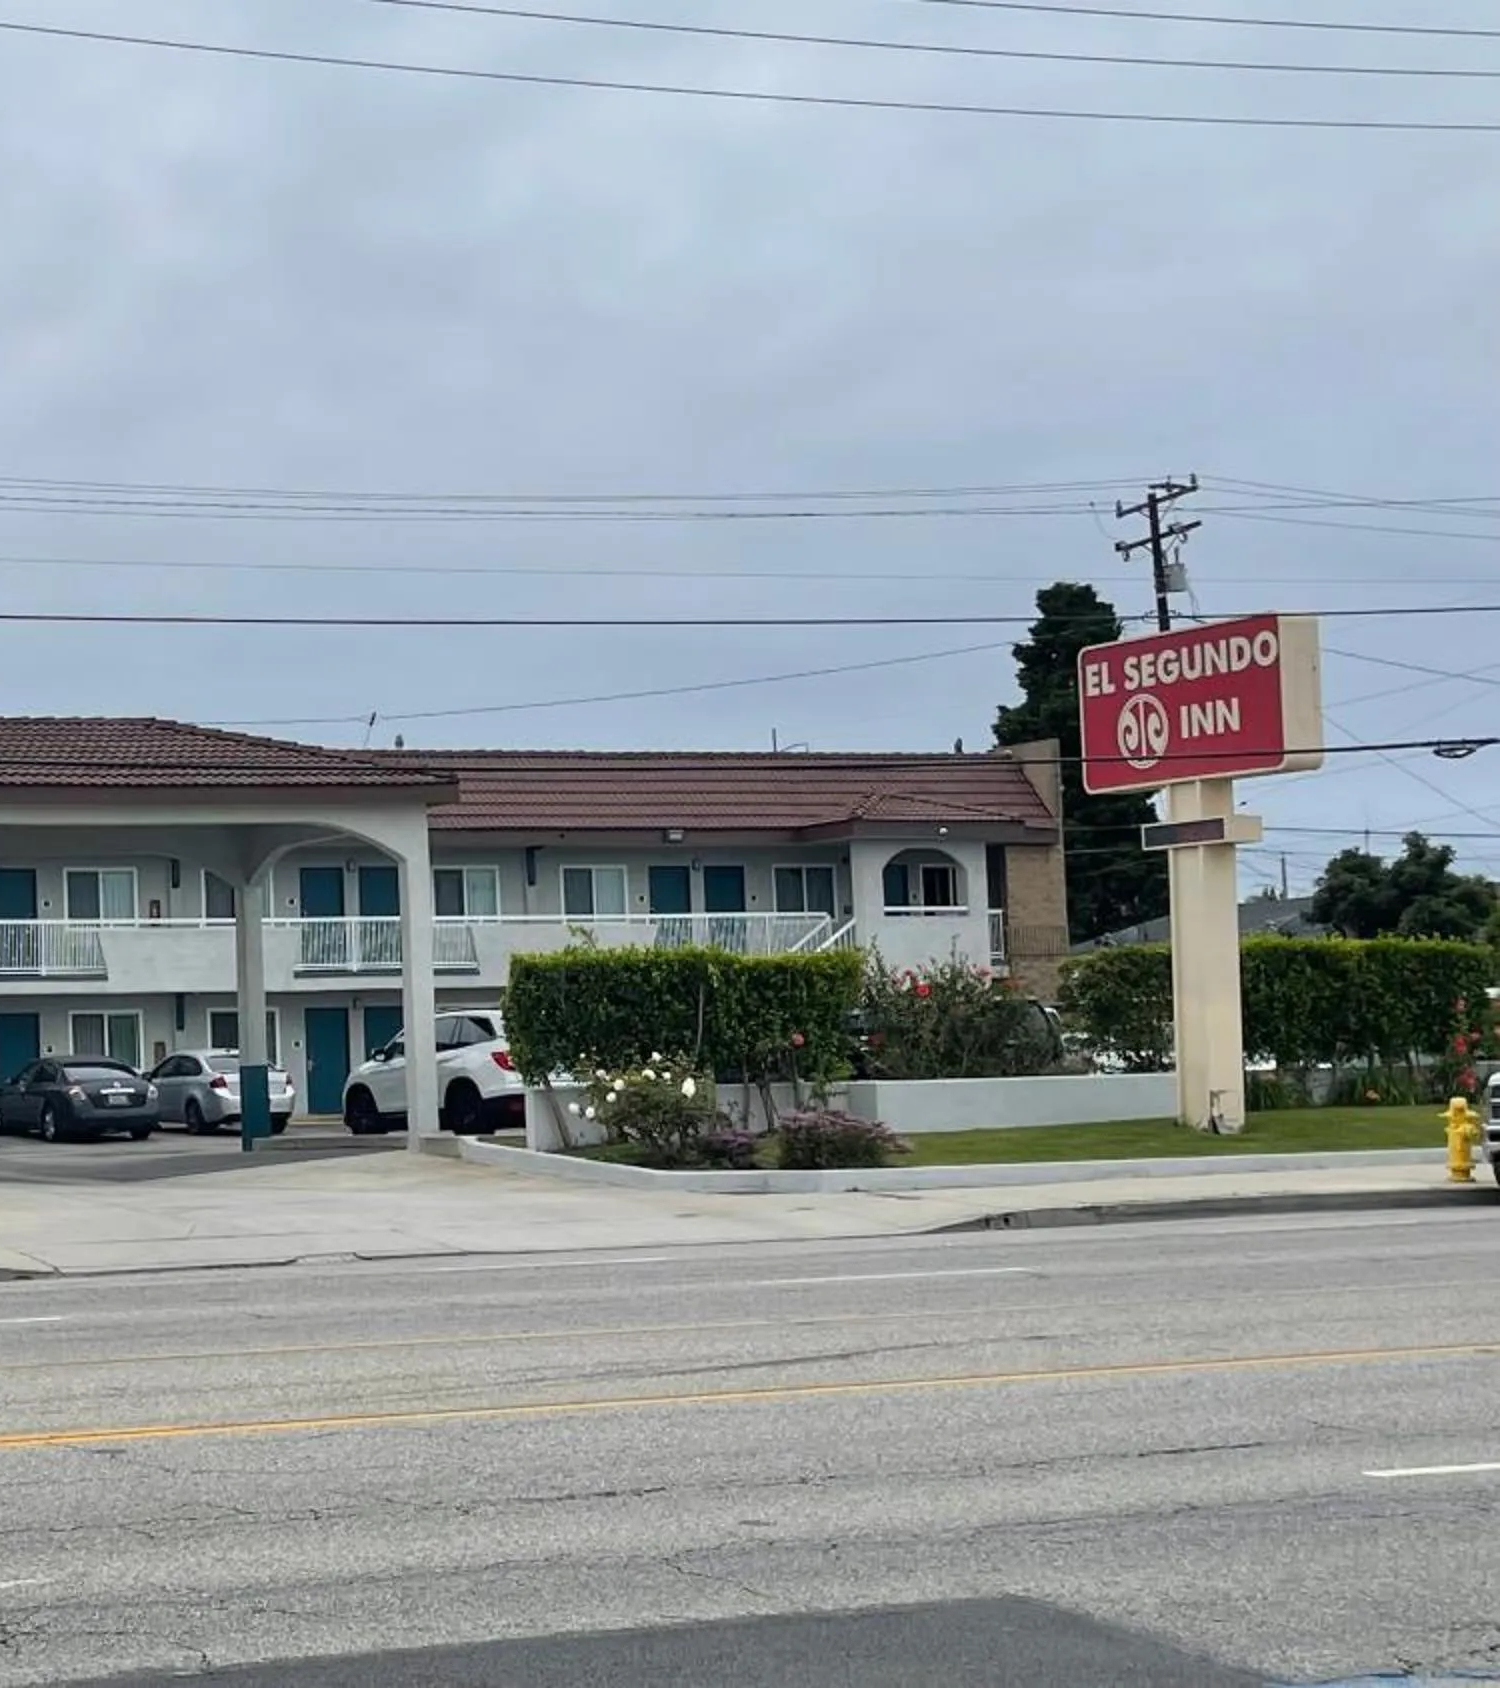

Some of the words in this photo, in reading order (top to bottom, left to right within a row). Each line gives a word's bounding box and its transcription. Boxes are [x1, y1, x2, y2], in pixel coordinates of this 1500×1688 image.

[1085, 661, 1116, 697] EL
[1123, 630, 1278, 691] SEGUNDO
[1180, 697, 1241, 739] INN
